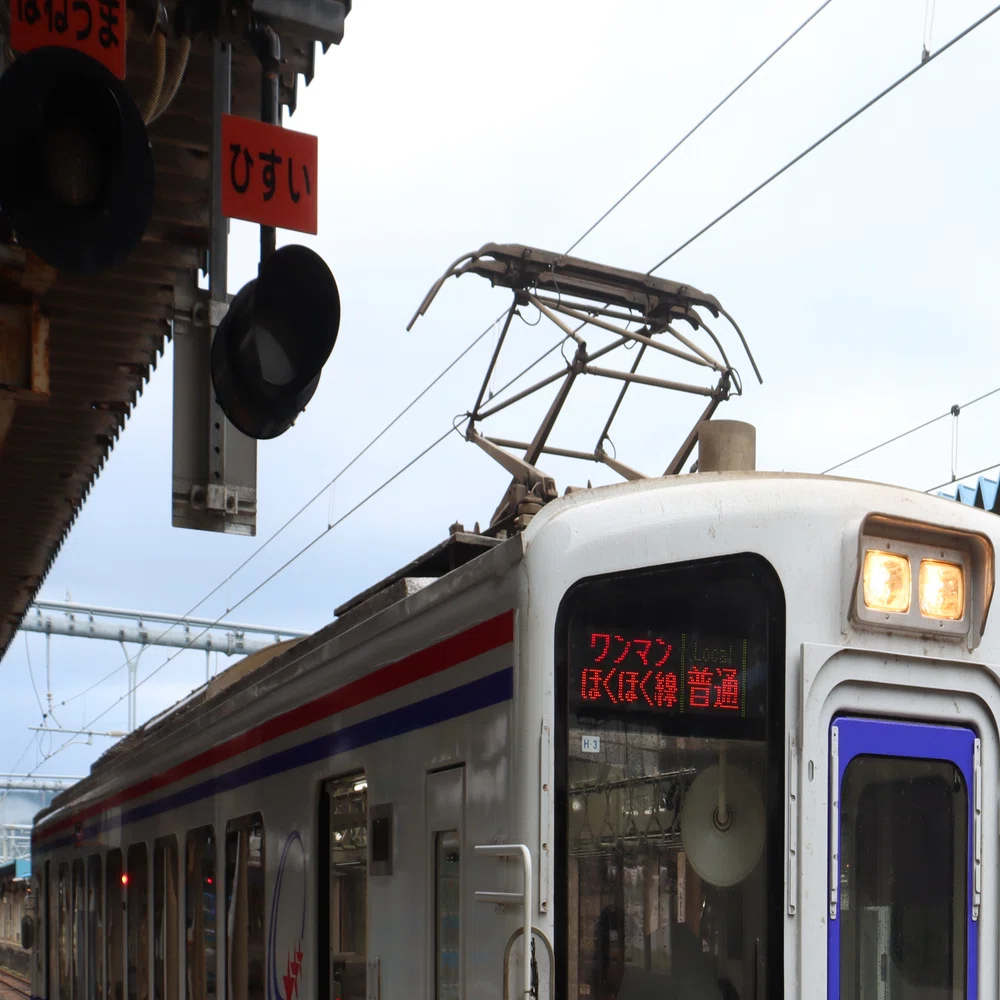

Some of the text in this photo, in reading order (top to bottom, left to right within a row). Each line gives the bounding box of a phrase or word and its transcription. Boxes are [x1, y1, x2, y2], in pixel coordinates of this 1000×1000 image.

[230, 144, 311, 204] ひすい
[591, 633, 672, 667] ワンマン
[581, 668, 677, 707] ほくほく線
[687, 666, 740, 709] 普通
